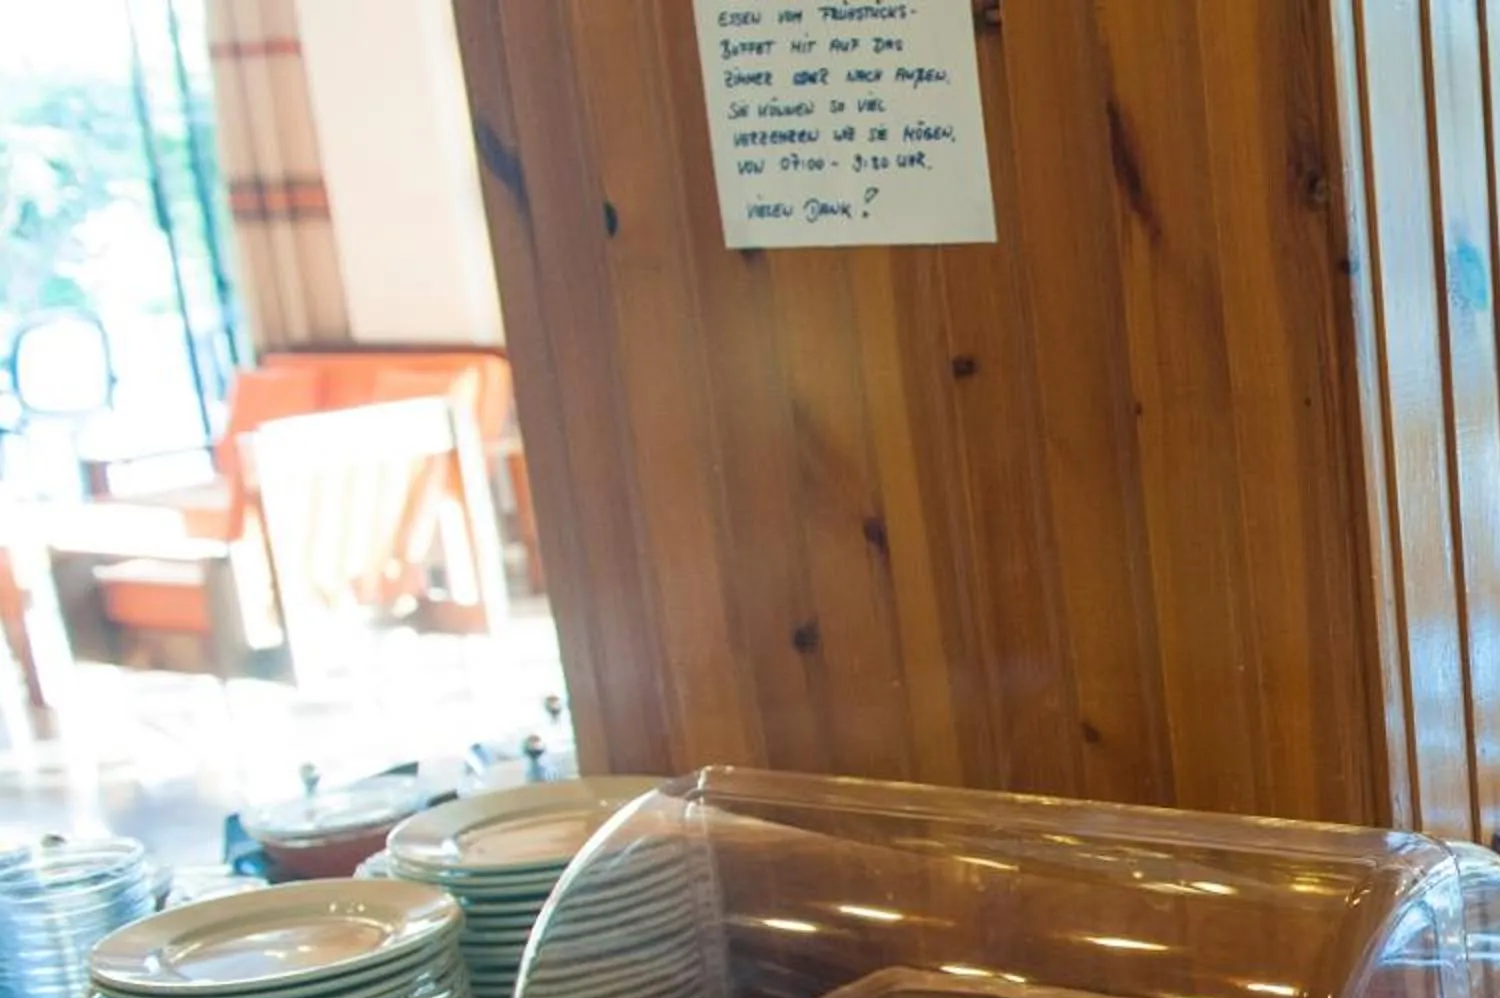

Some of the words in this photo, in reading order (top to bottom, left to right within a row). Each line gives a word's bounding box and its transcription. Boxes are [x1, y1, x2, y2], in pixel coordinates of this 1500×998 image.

[718, 10, 761, 27] ESSEN
[778, 9, 803, 24] VOM
[720, 39, 775, 59] BUFFET
[829, 38, 859, 52] AUF
[873, 37, 903, 54] DAS
[793, 68, 829, 85] ODER
[846, 69, 884, 82] NACH
[757, 96, 815, 118] KÖNNEN
[829, 99, 845, 114] SO
[733, 129, 819, 148] VERZEHREN
[737, 159, 765, 175] VON
[781, 152, 825, 171] 07:00
